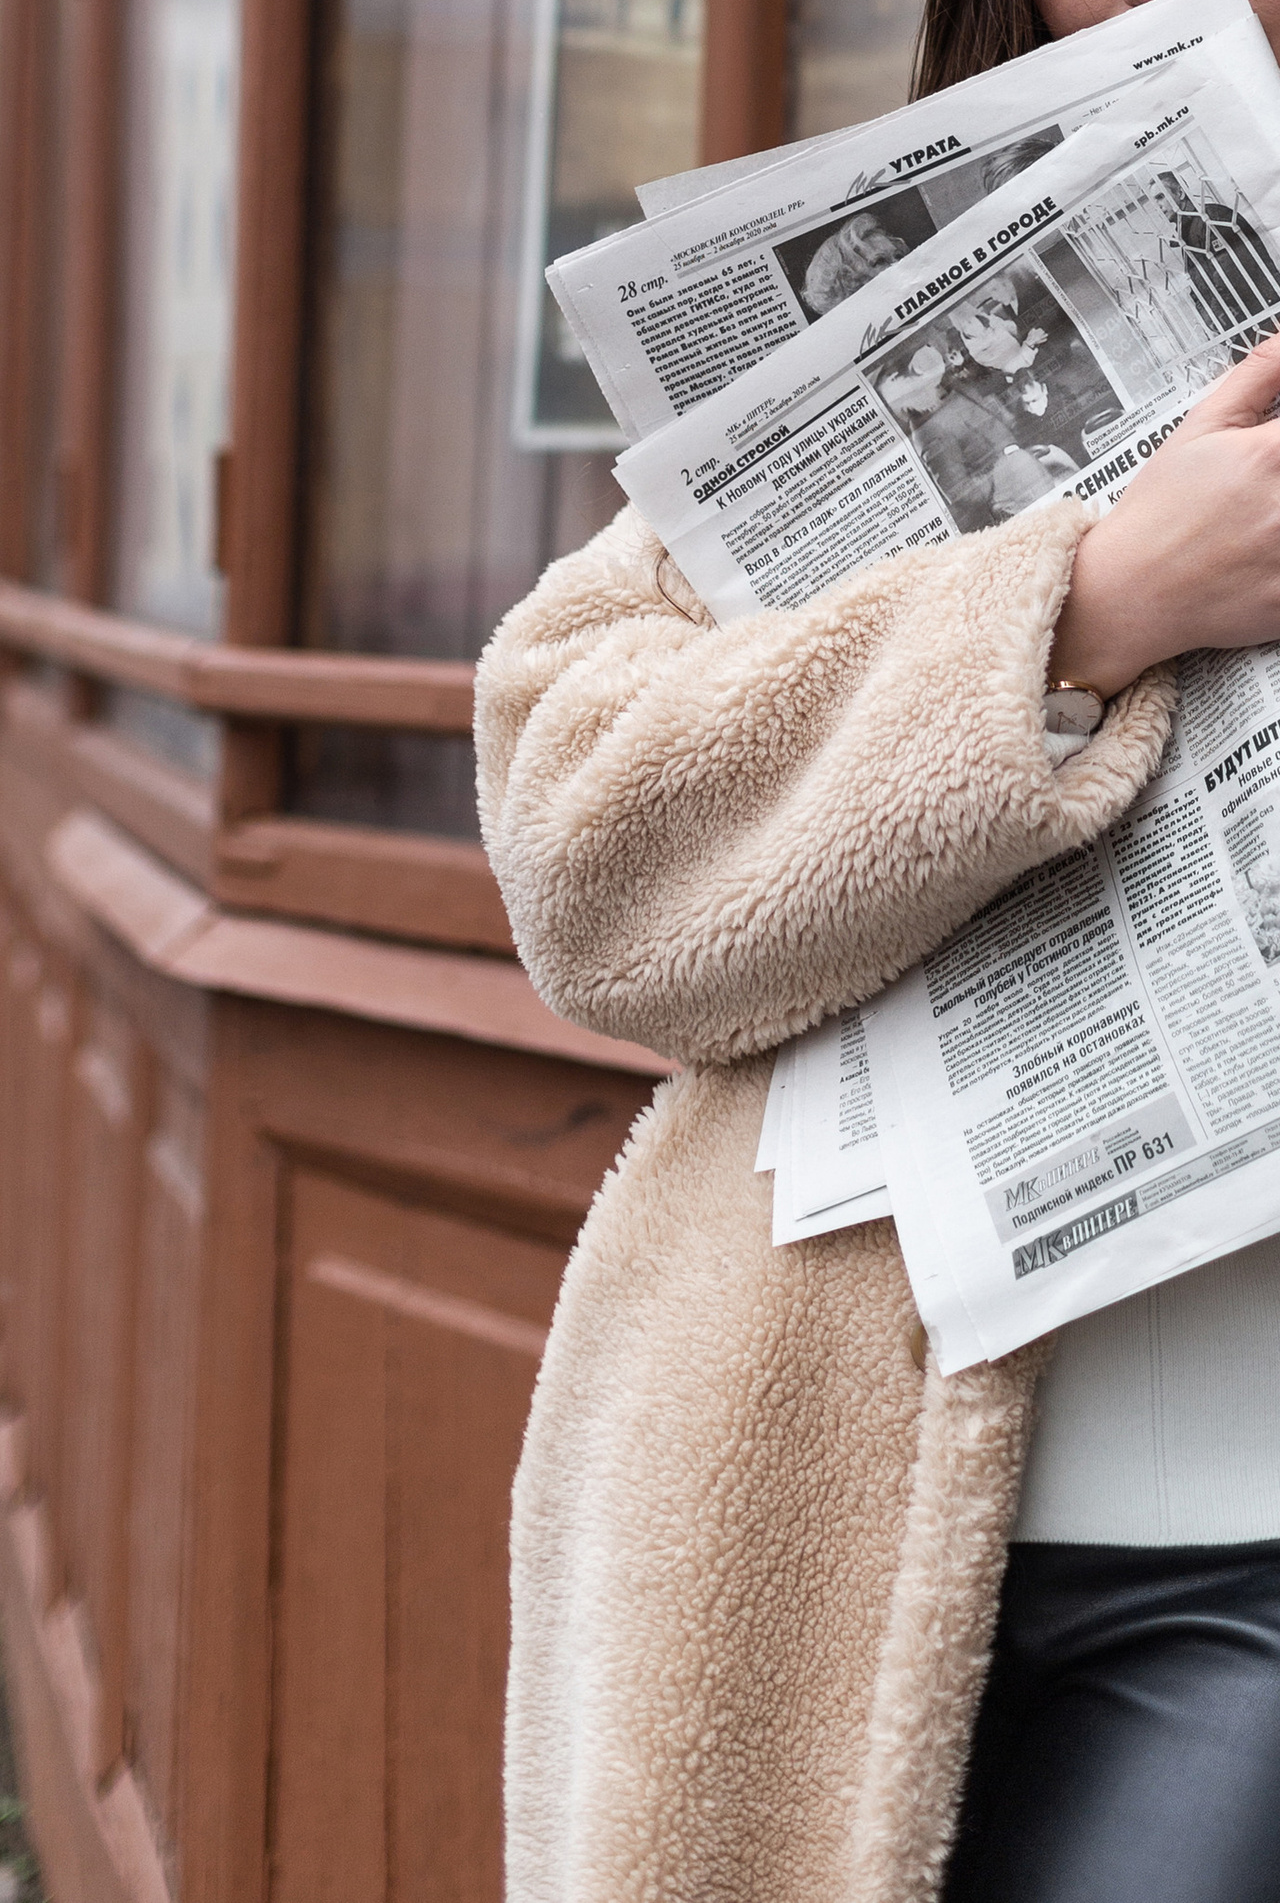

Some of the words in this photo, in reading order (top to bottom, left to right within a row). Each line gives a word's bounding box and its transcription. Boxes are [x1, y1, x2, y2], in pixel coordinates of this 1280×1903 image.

[1131, 35, 1205, 72] www.mk.ru
[887, 133, 963, 175] УТРАТА
[1133, 105, 1189, 149] spb.mk.ru
[625, 305, 646, 318] Они
[647, 293, 674, 309] были
[676, 273, 719, 297] знакомы
[720, 265, 734, 277] 65
[736, 258, 756, 271] лет,
[893, 256, 974, 321] ГЛАВНОЕ
[971, 246, 987, 263] В
[986, 195, 1057, 252] ГОРОДЕ
[616, 279, 638, 303] 28
[639, 275, 668, 293] стр.
[630, 316, 647, 327] тех
[646, 303, 676, 321] самых
[676, 295, 697, 308] пор,
[697, 282, 724, 299] когда
[730, 262, 769, 284] комнату
[635, 310, 688, 337] общежития
[688, 293, 729, 313] ГИТИСа,
[731, 280, 755, 295] куда
[757, 273, 773, 284] по-
[640, 327, 672, 346] селили
[644, 333, 686, 355] ворвался
[686, 310, 735, 338] худенький
[734, 294, 774, 316] паренек
[648, 347, 680, 365] Роман
[679, 331, 718, 351] Виктюк.
[718, 322, 737, 335] Без
[737, 313, 758, 327] пяти
[759, 300, 787, 317] минут
[752, 319, 797, 342] взглядом
[1085, 423, 1119, 448] Горожане
[1118, 405, 1144, 428] дичают
[1152, 384, 1177, 403] только
[679, 467, 693, 486] 2
[694, 456, 720, 478] стр.
[692, 463, 737, 500] ОДНОЙ
[736, 424, 792, 468] СТРОКОЙ
[715, 495, 728, 510] К
[724, 468, 767, 503] Новому
[766, 449, 793, 474] году
[791, 424, 828, 458] улицы
[826, 394, 869, 433] украсят
[770, 448, 822, 492] детскими
[820, 407, 878, 456] рисунками
[1090, 439, 1110, 456] из-за
[743, 552, 773, 576] Вход
[770, 546, 780, 558] в
[837, 486, 862, 509] стал
[861, 453, 908, 492] платным
[904, 515, 943, 548] против
[1204, 739, 1251, 792] БУДУТ
[1236, 756, 1273, 788] Новые
[931, 975, 986, 1019] Смольный
[986, 940, 1047, 987] расследует
[1048, 904, 1111, 948] отравление
[972, 972, 1017, 1008] голубей
[1016, 969, 1024, 984] у
[1023, 938, 1080, 977] Гостиного
[1081, 918, 1115, 946] двора
[1005, 1061, 1060, 1100] появился
[1061, 1052, 1077, 1068] на
[1078, 1013, 1145, 1058] остановках
[1011, 1042, 1064, 1079] Злобный
[1065, 999, 1140, 1048] коронавирус
[1045, 1146, 1101, 1187] ПИТЕРЕ
[1112, 1149, 1137, 1175] ПР
[1141, 1131, 1174, 1160] 631
[1011, 1190, 1073, 1229] Подписной
[1073, 1168, 1115, 1196] индекс
[1071, 1196, 1135, 1246] ПИТЕРЕ
